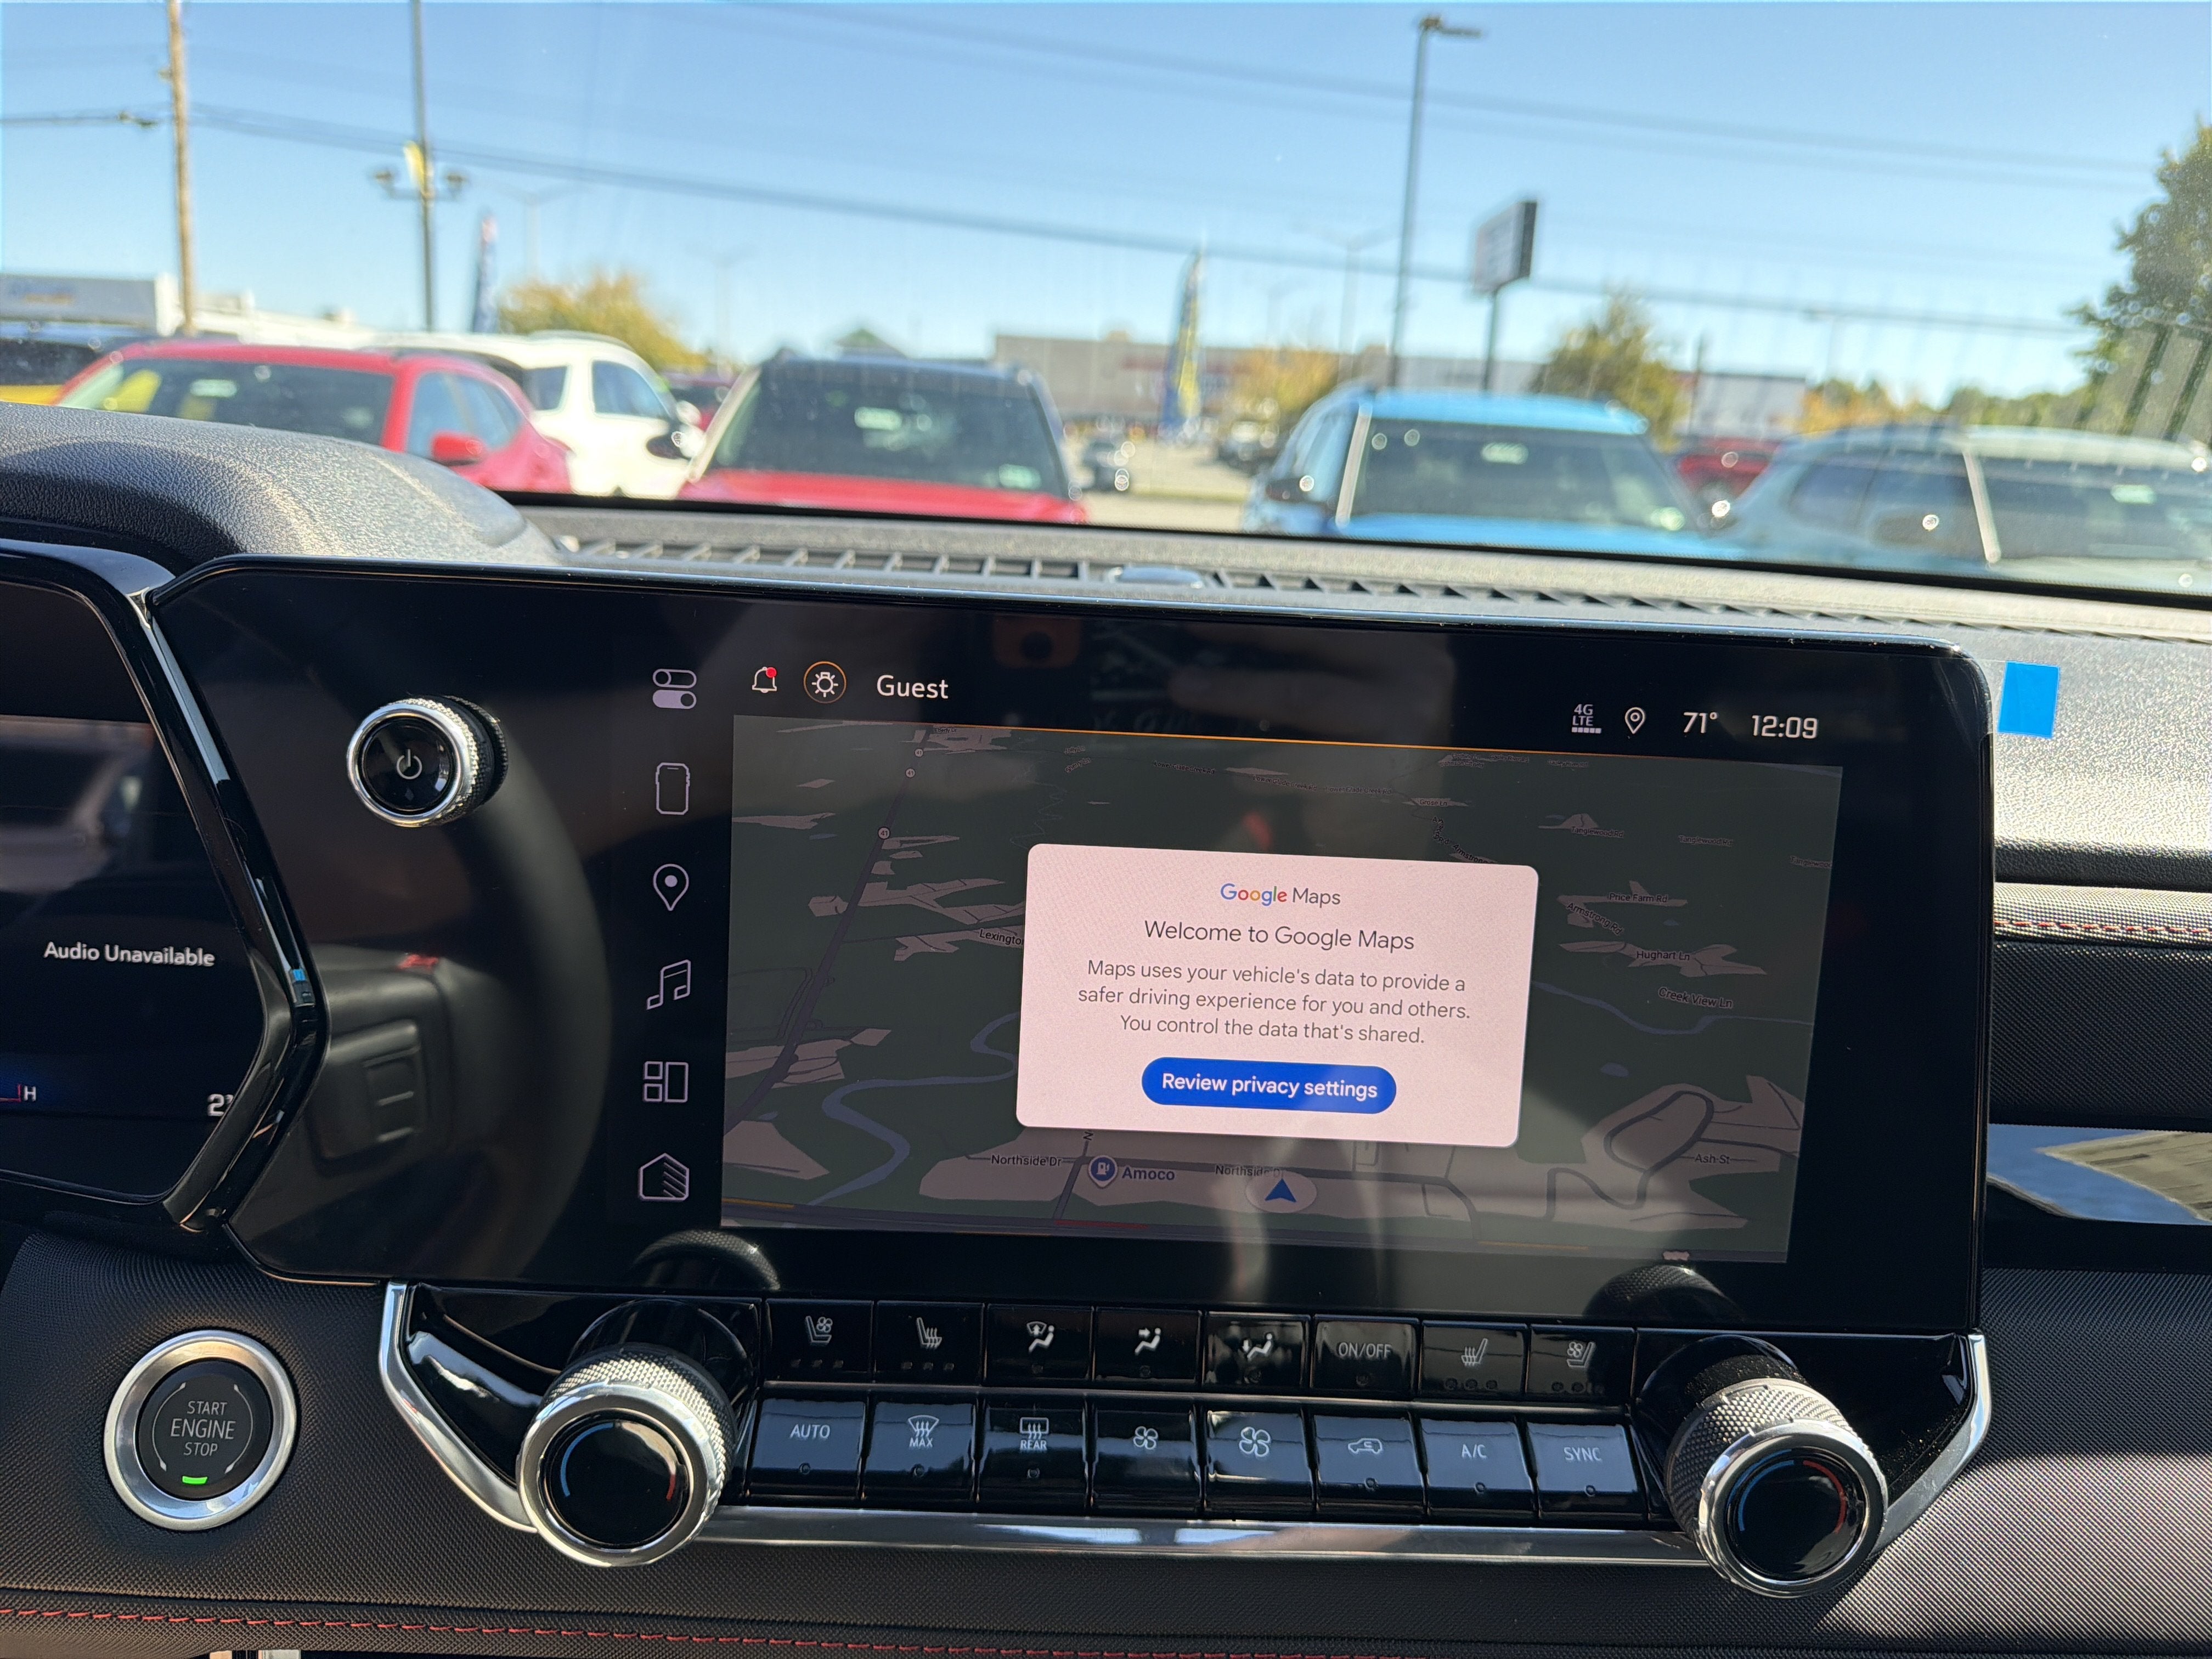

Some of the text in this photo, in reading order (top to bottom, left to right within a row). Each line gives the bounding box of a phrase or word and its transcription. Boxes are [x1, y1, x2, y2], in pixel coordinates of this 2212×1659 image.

[877, 675, 949, 699] Guest
[1573, 704, 1594, 715] 4G
[1572, 716, 1594, 726] LTE
[1683, 712, 1718, 733] 71°
[1752, 715, 1818, 739] 12:09
[1571, 826, 1612, 837] Tanglewood
[1678, 835, 1722, 845] Tanglewood
[1220, 883, 1341, 908] Google Maps
[1609, 893, 1630, 901] Price
[1632, 894, 1654, 902] Farm
[1566, 902, 1623, 935] Armstrong Rd
[1144, 921, 1415, 953] Welcome to Google Maps
[44, 941, 215, 967] Audio Unavailable
[1637, 950, 1690, 962] Hughart Ln
[1087, 960, 1465, 992] Maps uses your vehicle's data to provide a
[1078, 986, 1470, 1019] safer driving experience for you and others.
[1658, 988, 1733, 1008] Creek View Ln
[1120, 1015, 1425, 1044] You control the data that's shared.
[24, 1086, 36, 1101] H
[1163, 1072, 1377, 1101] Review privacy settings
[991, 1154, 1062, 1166] Northside Dr
[1695, 1153, 1730, 1164] Ash St
[1122, 1166, 1175, 1181] Amoco
[1216, 1165, 1269, 1177] Northside
[1338, 1341, 1393, 1359] ON/OFF
[187, 1401, 227, 1415] START
[171, 1418, 236, 1440] ENGINE
[790, 1424, 831, 1440] AUTO
[183, 1442, 218, 1457] STOP
[909, 1437, 933, 1449] MAX
[1020, 1439, 1047, 1452] REAR
[1462, 1444, 1487, 1460] A/C
[1564, 1446, 1601, 1463] SYNC
